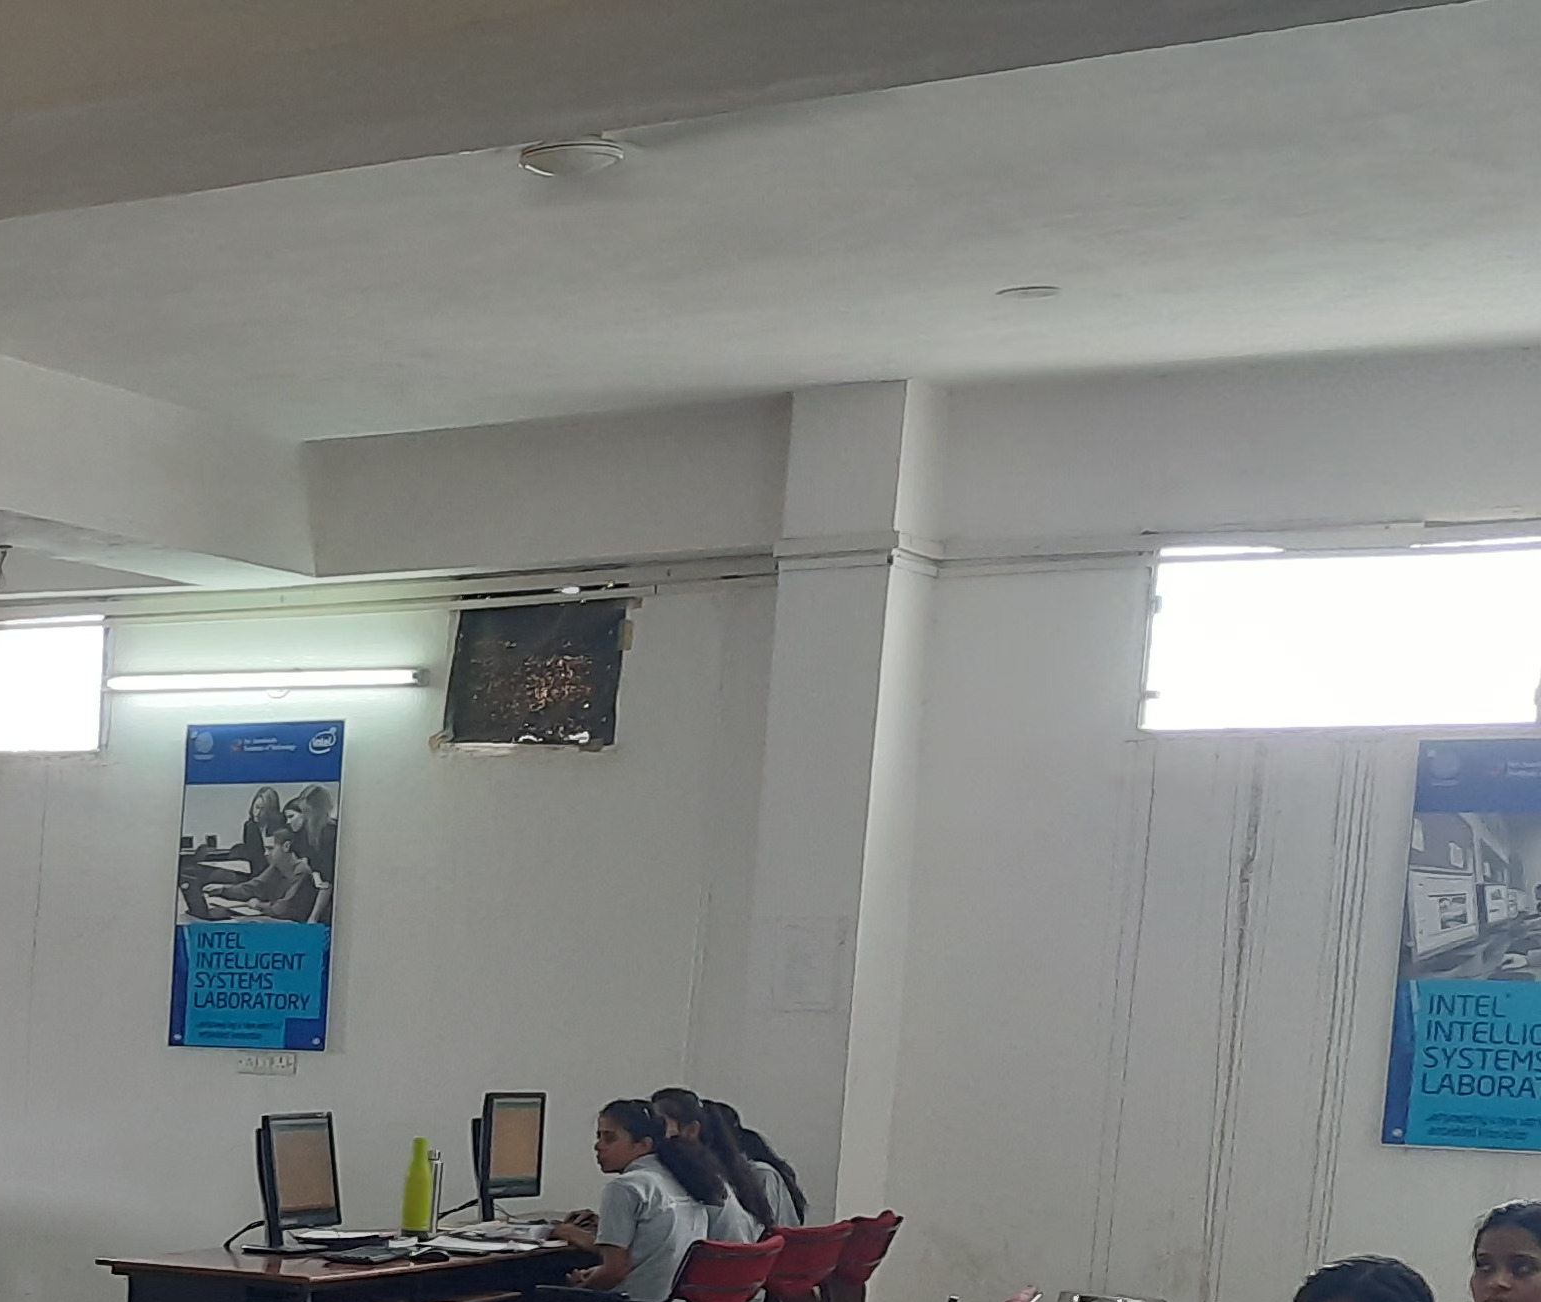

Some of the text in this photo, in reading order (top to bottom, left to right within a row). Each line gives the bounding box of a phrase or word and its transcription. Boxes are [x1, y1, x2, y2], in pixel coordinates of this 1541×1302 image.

[197, 931, 245, 949] INTEL
[196, 952, 306, 970] INTELLIGENT
[194, 971, 273, 990] SYSTEMS
[194, 991, 311, 1011] LABORATORY
[1428, 994, 1506, 1017] INTEL
[1426, 1019, 1541, 1046] INTELLIG
[1421, 1072, 1541, 1099] LABORA
